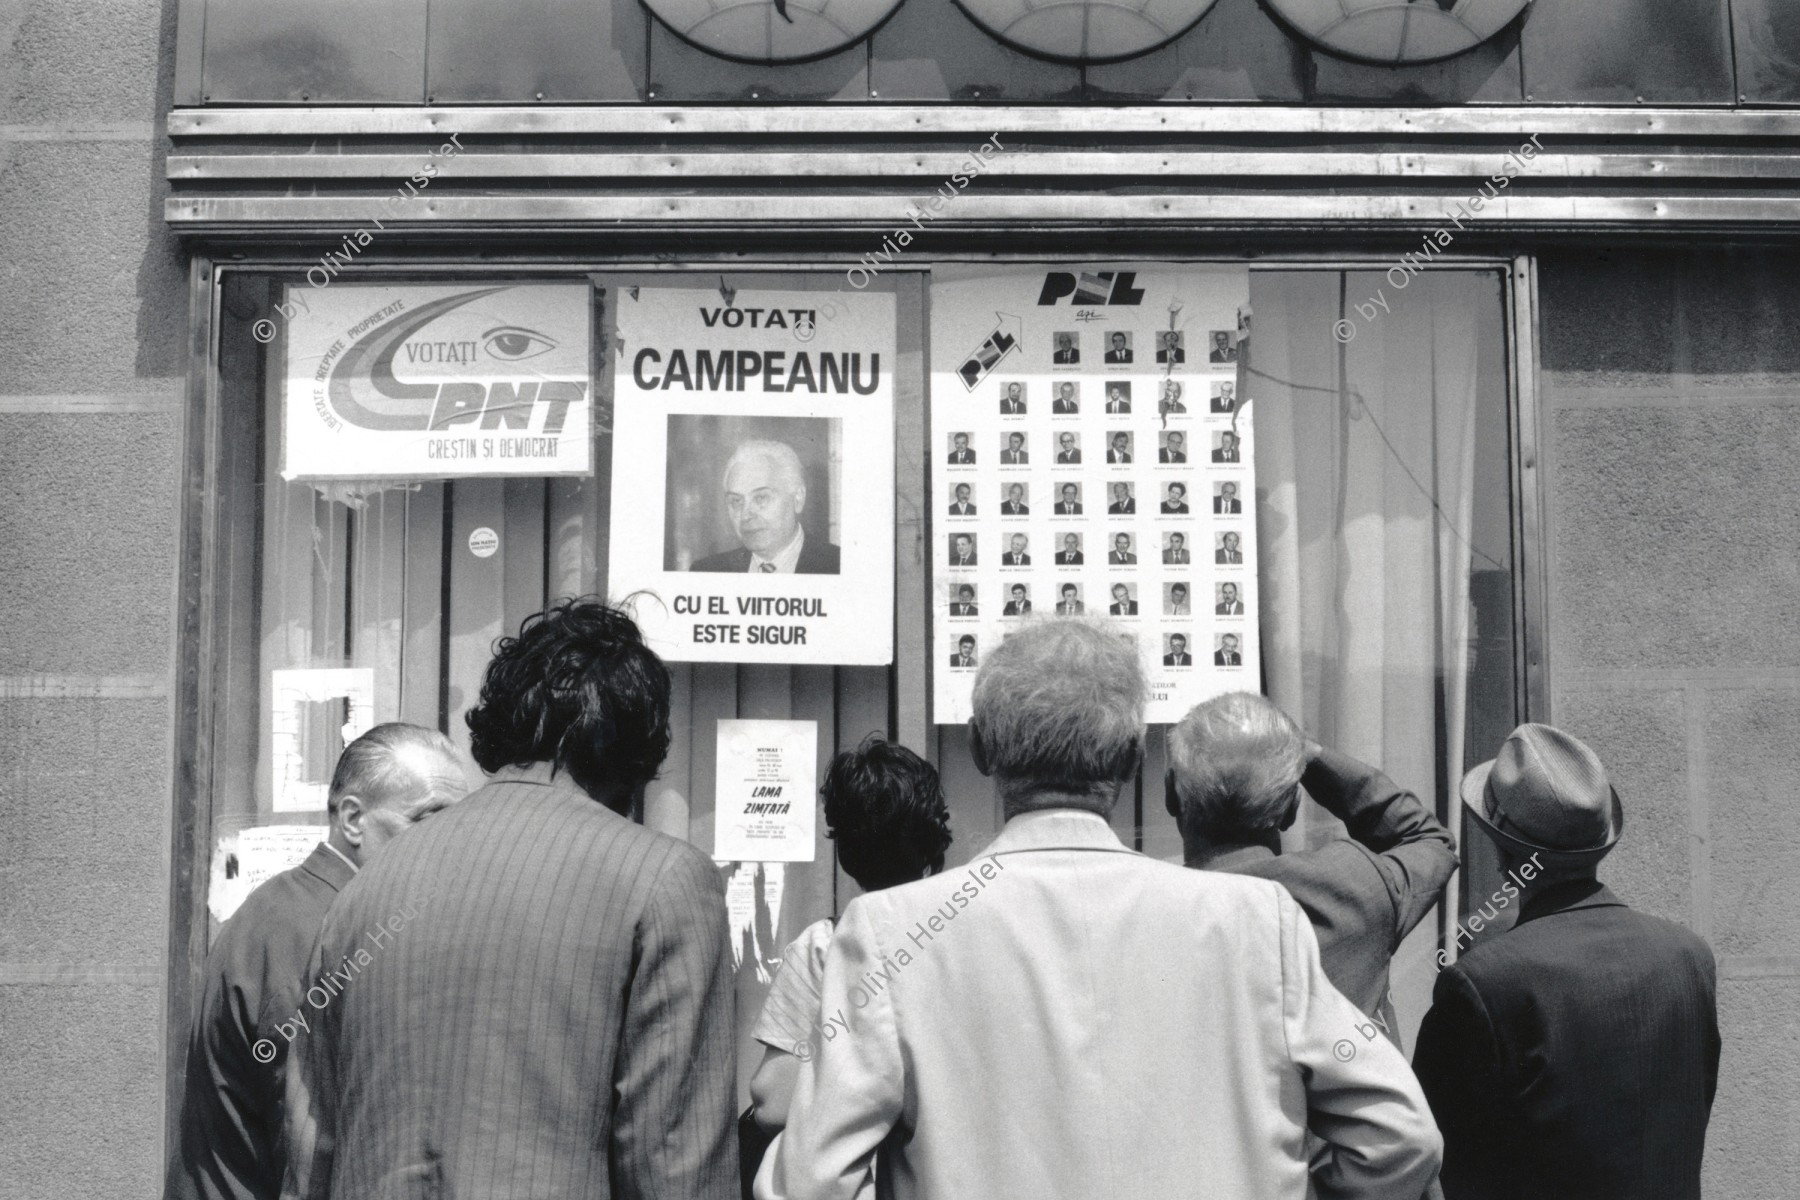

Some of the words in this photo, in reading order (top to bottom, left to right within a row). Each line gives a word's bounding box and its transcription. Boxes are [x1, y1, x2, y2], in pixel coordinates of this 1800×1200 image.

[347, 299, 405, 339] PROPRIETATE
[315, 339, 346, 383] DREPTATE
[632, 347, 880, 395] CAMPEANU
[313, 388, 343, 433] LIBERTATE
[500, 437, 559, 459] DEMOCRAT
[673, 595, 702, 615] CU
[708, 596, 729, 615] EL
[737, 596, 827, 617] VIITORUL
[693, 624, 740, 644] ESTE
[747, 625, 807, 645] SIGUR
[751, 786, 783, 798] LAMA
